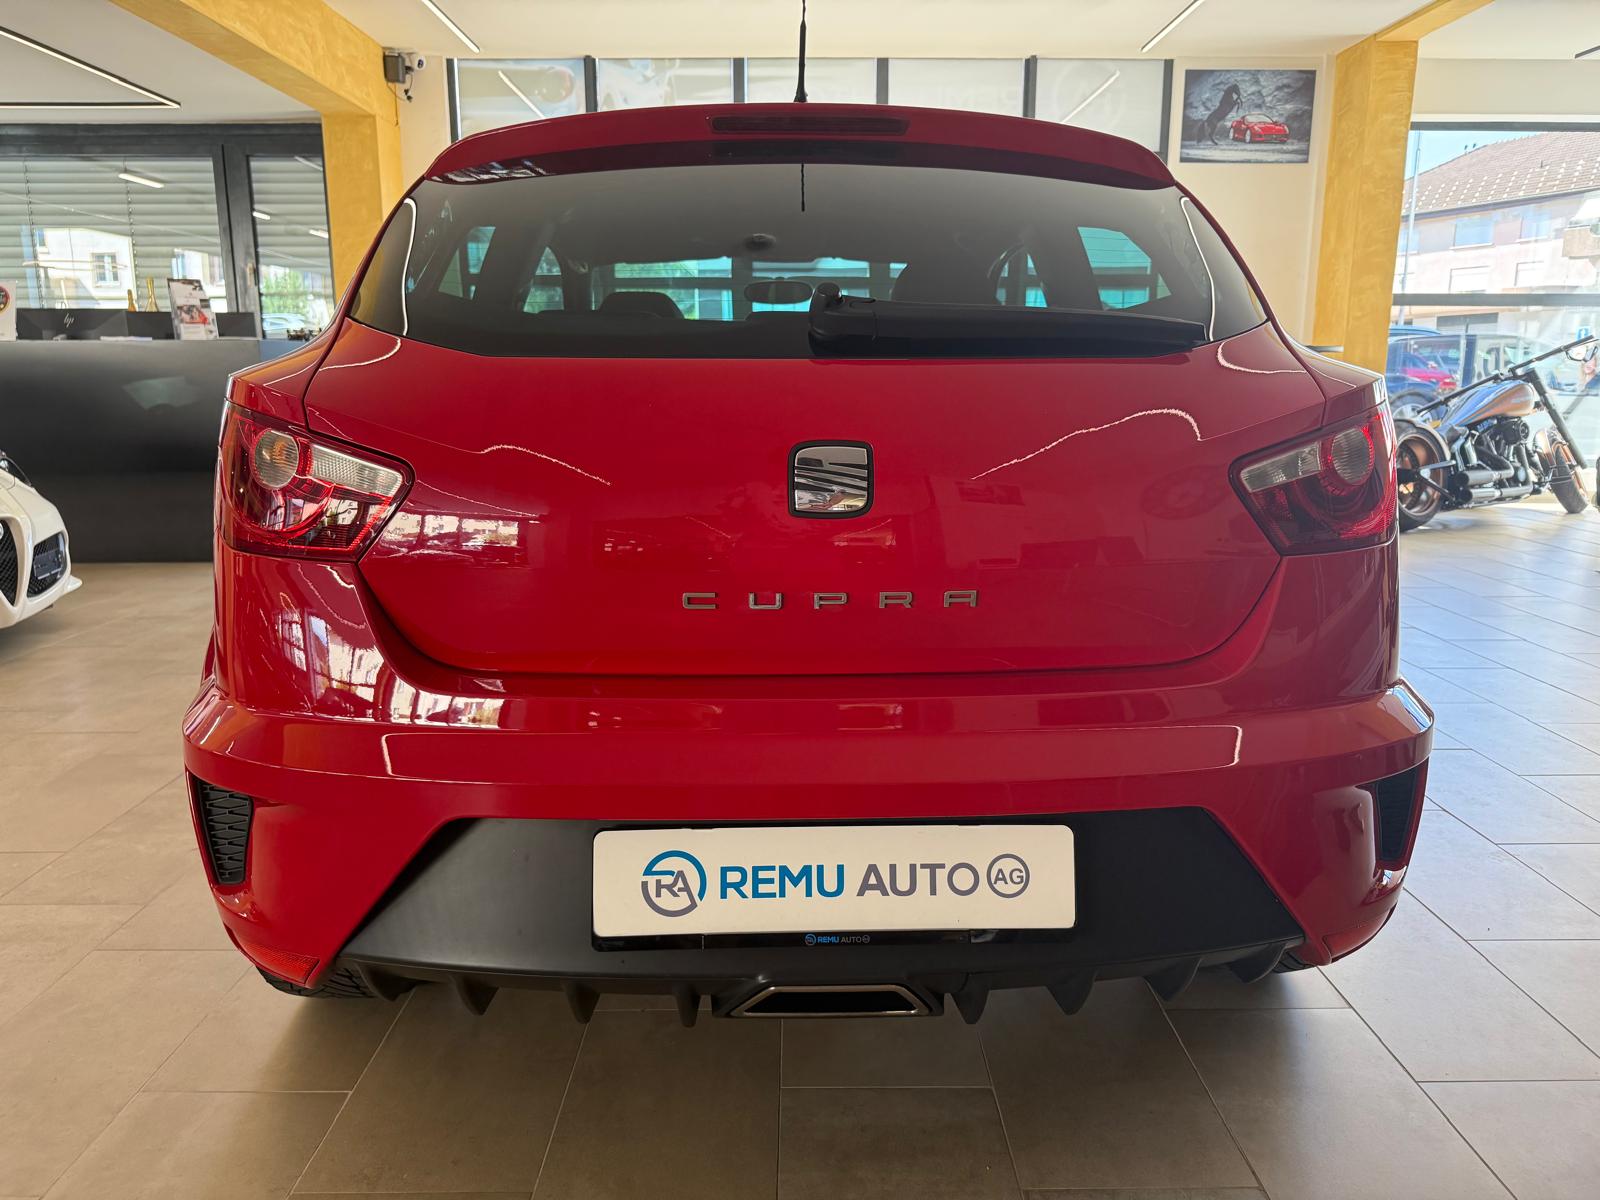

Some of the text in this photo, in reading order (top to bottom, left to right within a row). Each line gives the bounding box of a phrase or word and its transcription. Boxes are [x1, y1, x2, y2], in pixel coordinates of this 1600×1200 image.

[63, 312, 75, 328] hp
[682, 590, 978, 610] CUPRA
[719, 864, 845, 900] REMU
[855, 862, 980, 897] AUTO
